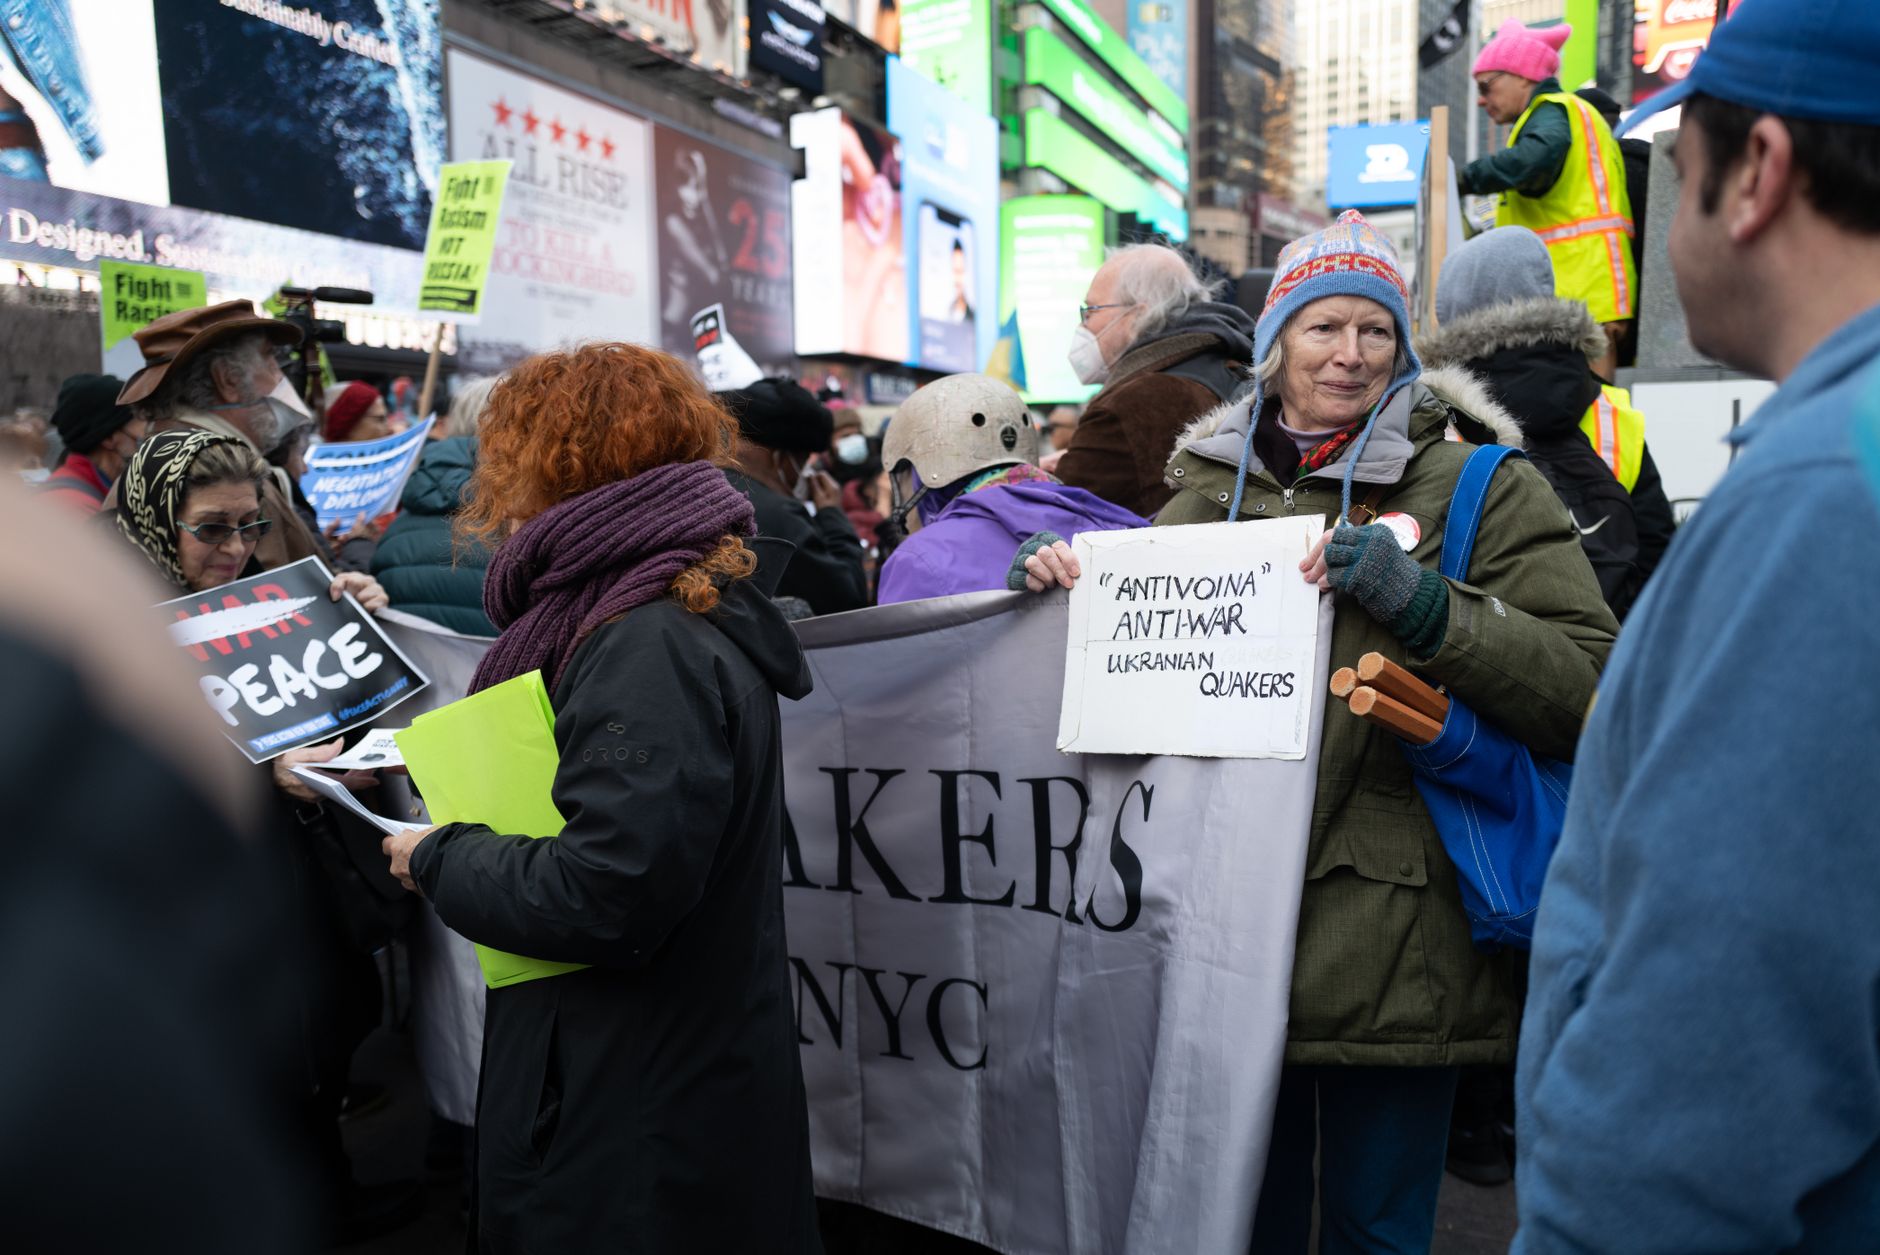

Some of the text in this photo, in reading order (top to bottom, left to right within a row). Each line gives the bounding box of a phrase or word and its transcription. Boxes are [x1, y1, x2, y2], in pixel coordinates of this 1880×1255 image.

[556, 155, 629, 210] RISE
[8, 207, 153, 263] Designed.
[728, 198, 788, 280] 25
[114, 272, 172, 302] Fight
[1112, 602, 1247, 640] ANTI-WAR
[200, 622, 383, 727] PEACE
[1107, 651, 1214, 674] UKRANIAN
[1199, 671, 1295, 698] QUAKERS
[788, 956, 988, 1071] NYC
